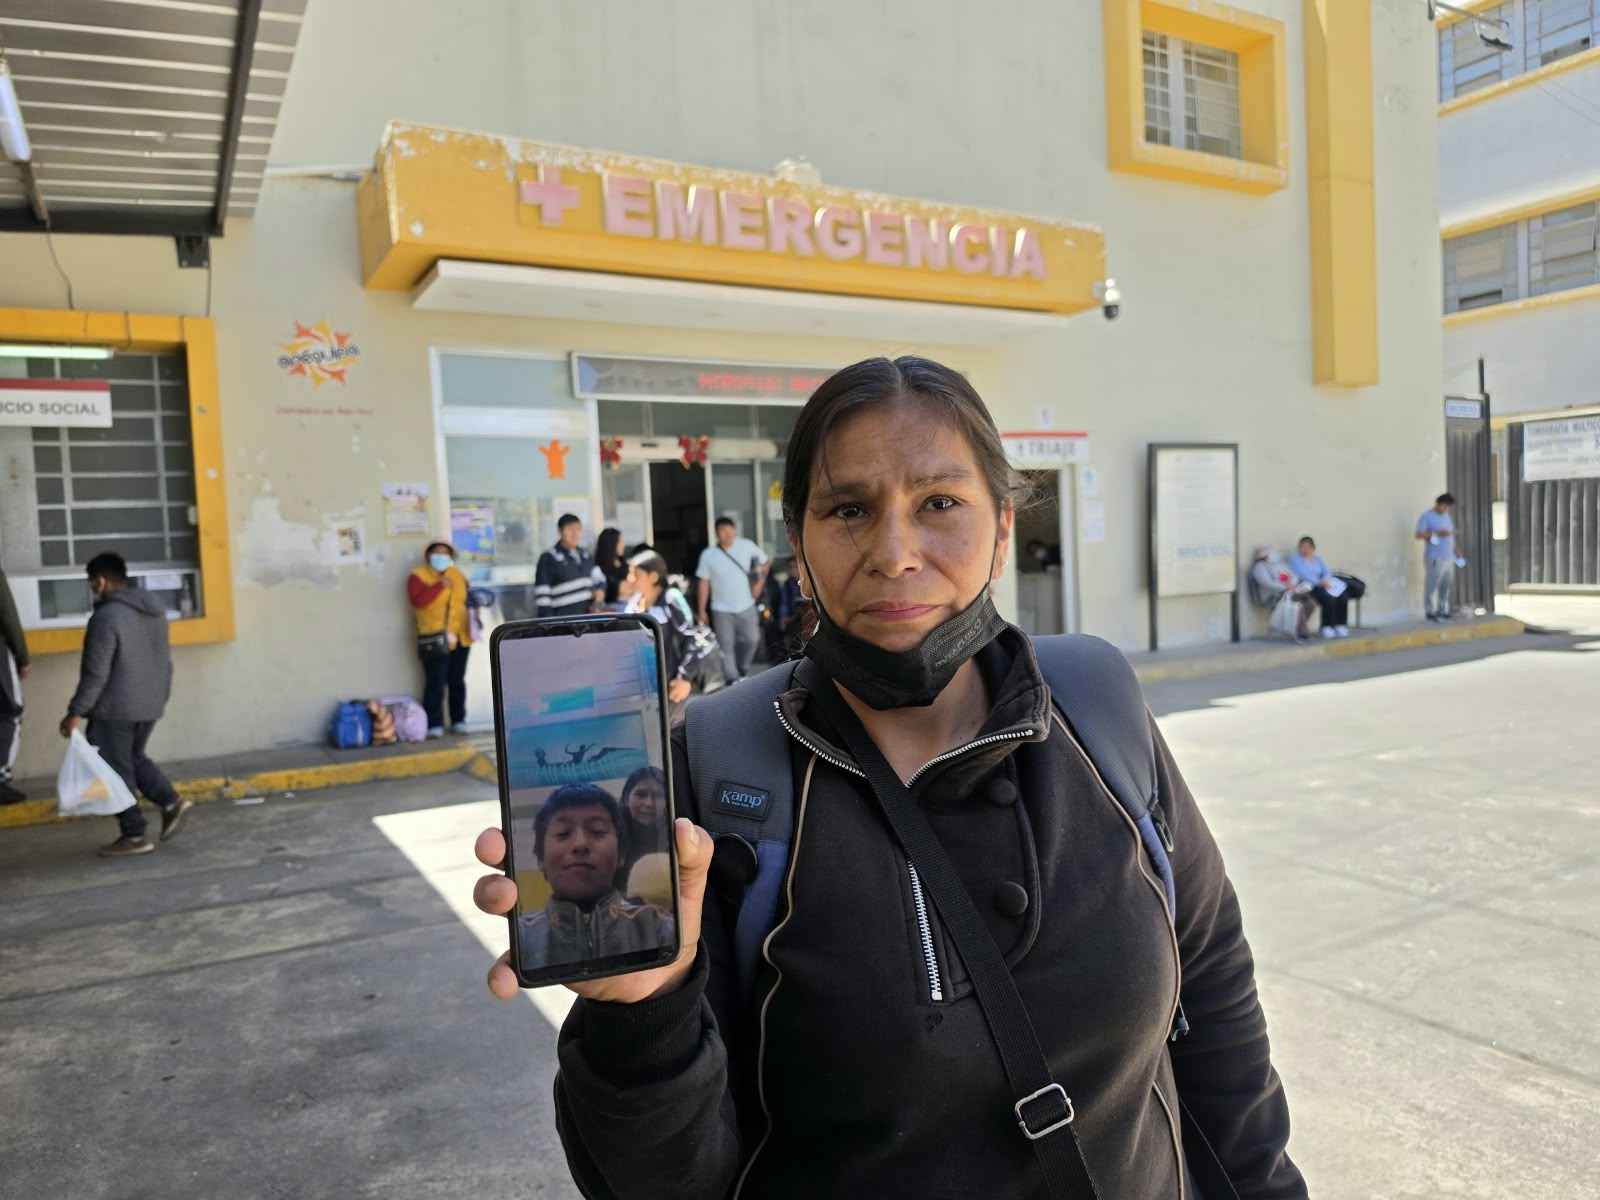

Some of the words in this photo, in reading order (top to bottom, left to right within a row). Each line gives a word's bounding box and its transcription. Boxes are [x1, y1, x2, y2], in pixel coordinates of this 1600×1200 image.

[601, 172, 1048, 281] EMERGENCIA
[39, 402, 101, 416] SOCIAL
[1028, 440, 1076, 458] TRIAJE
